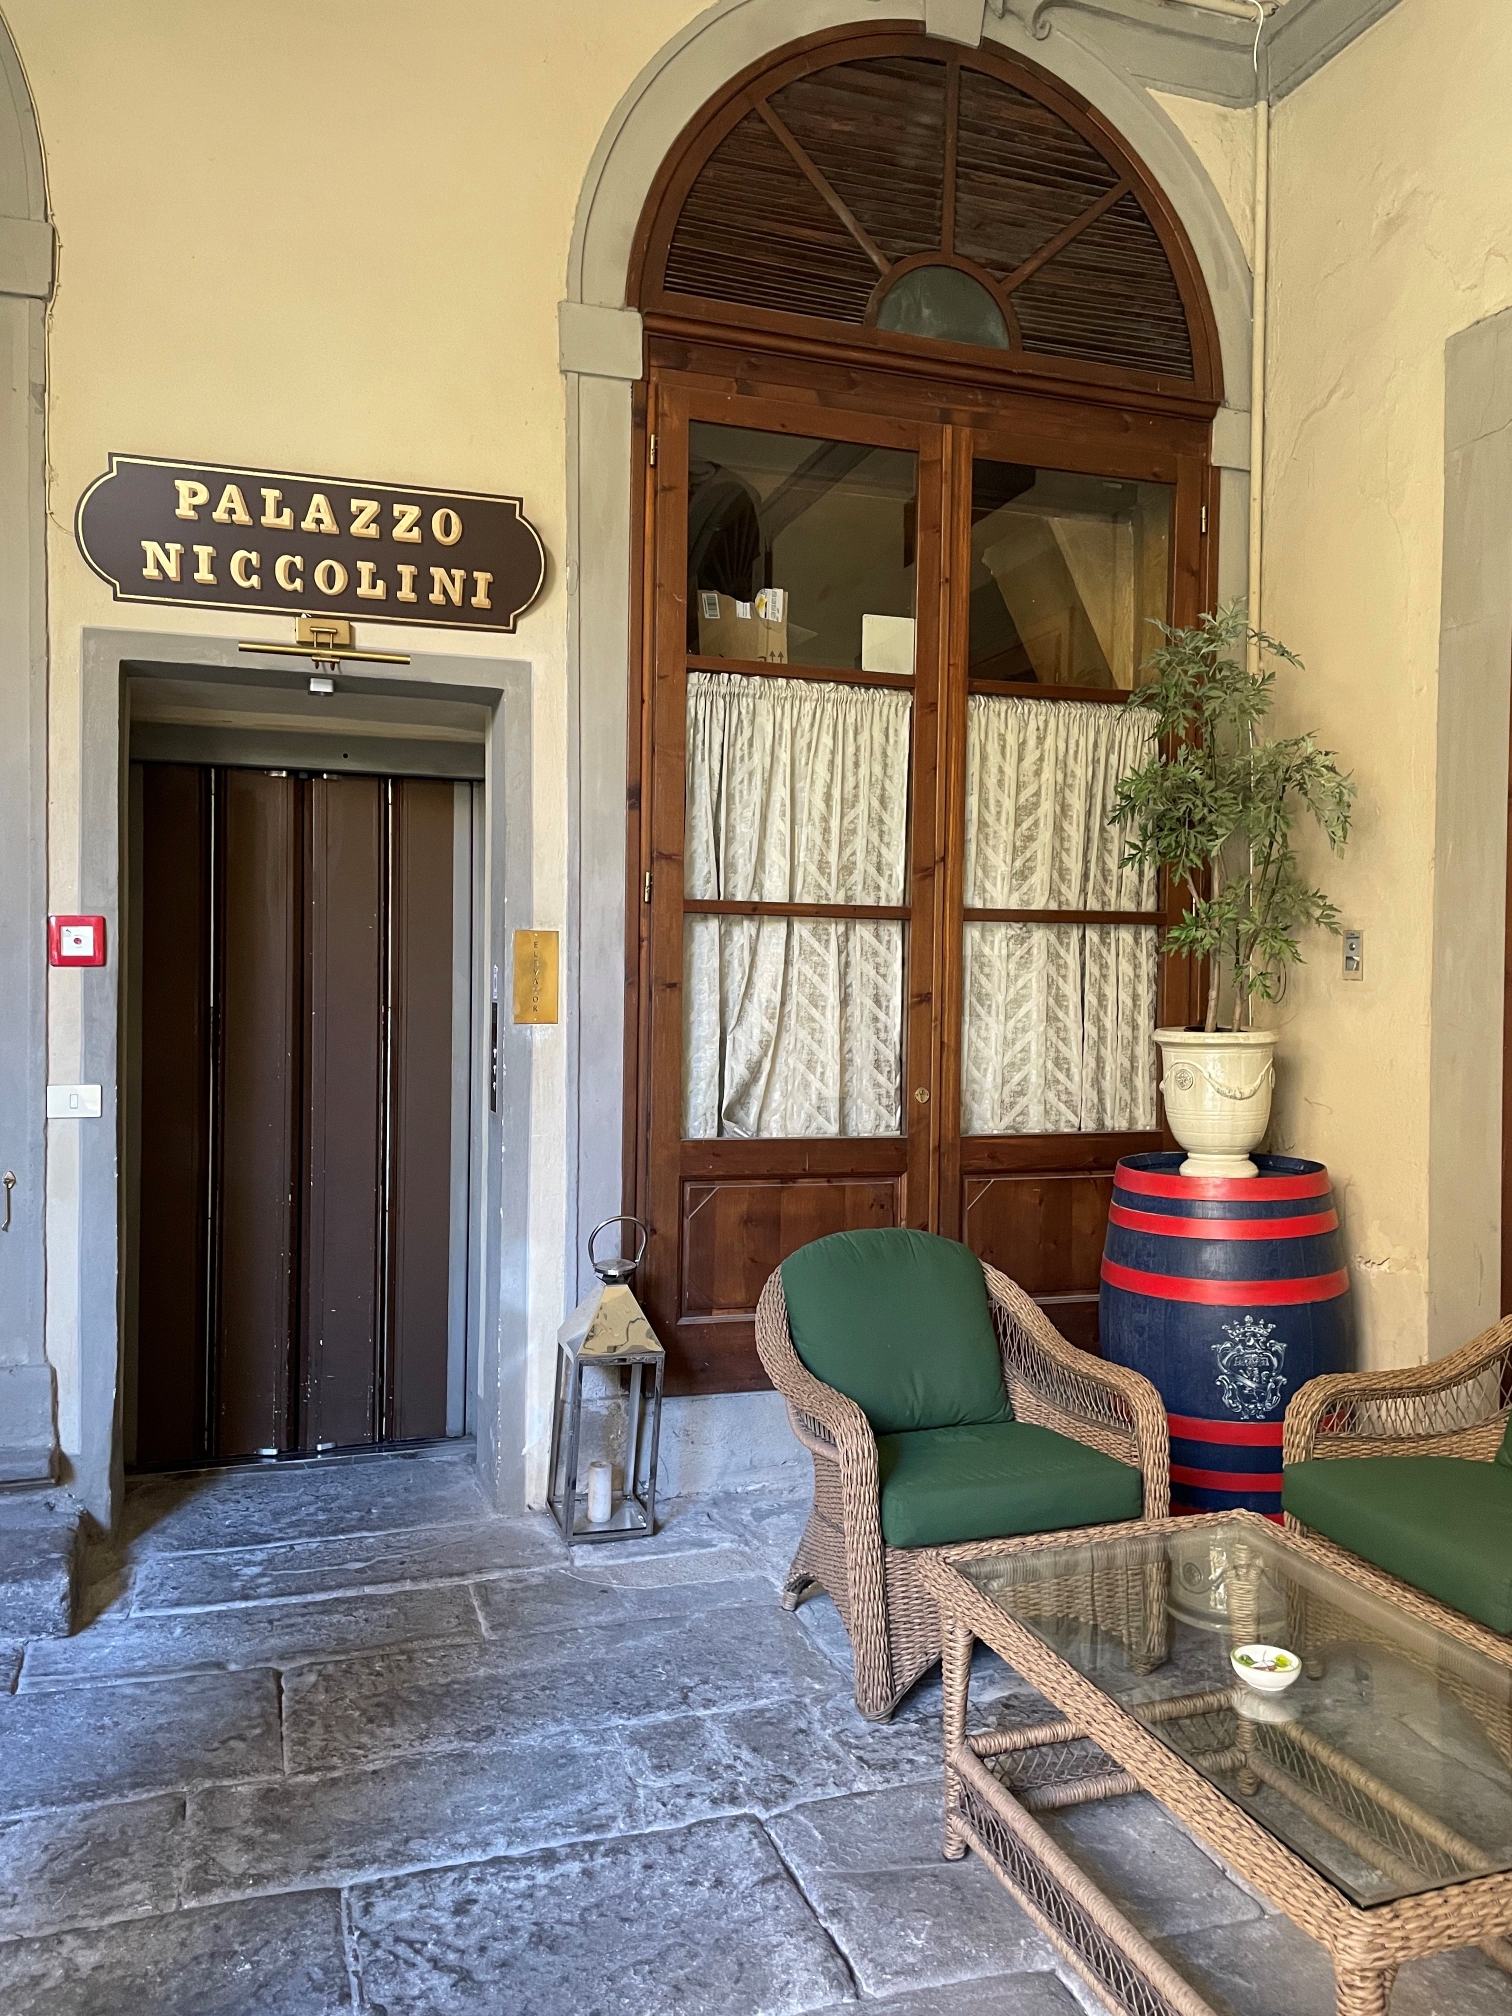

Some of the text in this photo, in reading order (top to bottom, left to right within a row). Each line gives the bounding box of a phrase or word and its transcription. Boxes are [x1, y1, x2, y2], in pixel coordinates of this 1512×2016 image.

[174, 479, 463, 546] PALAZZO
[141, 540, 493, 609] NICCOLINI
[532, 941, 540, 1012] ELEVATOR
